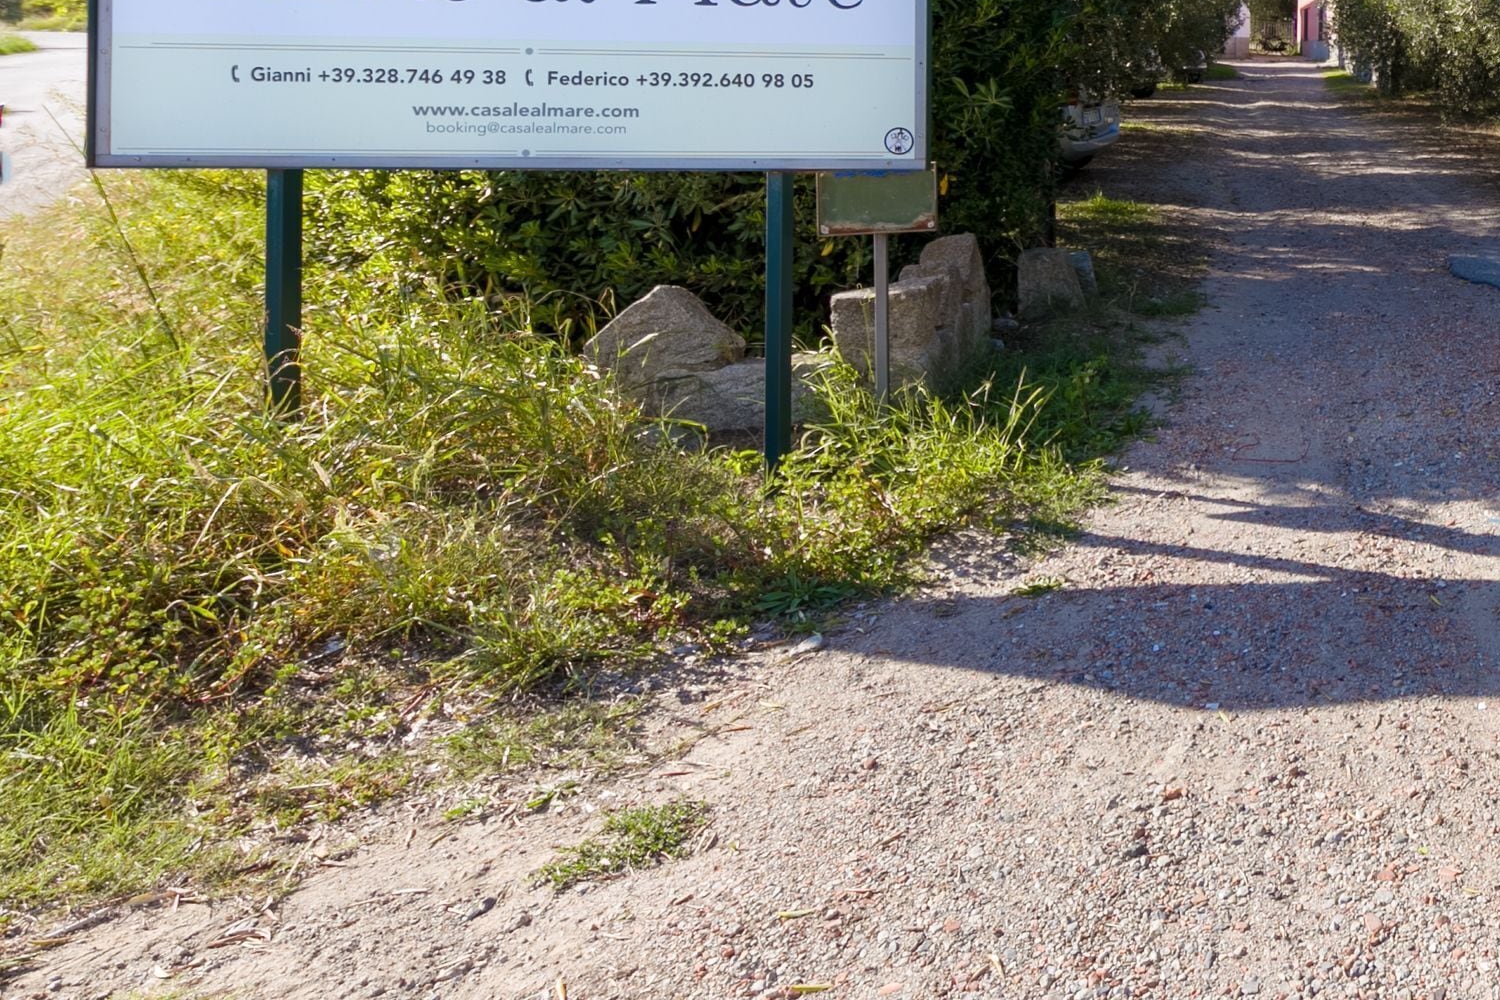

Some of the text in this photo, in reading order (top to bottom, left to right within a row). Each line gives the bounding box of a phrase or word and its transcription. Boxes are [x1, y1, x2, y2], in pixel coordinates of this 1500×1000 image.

[250, 66, 814, 89] Gianni +39.328.746 49 38 Federico +39.392.640 98 05
[412, 102, 640, 118] www.casalealmare.com
[426, 120, 627, 137] booking@casalealmare.com
